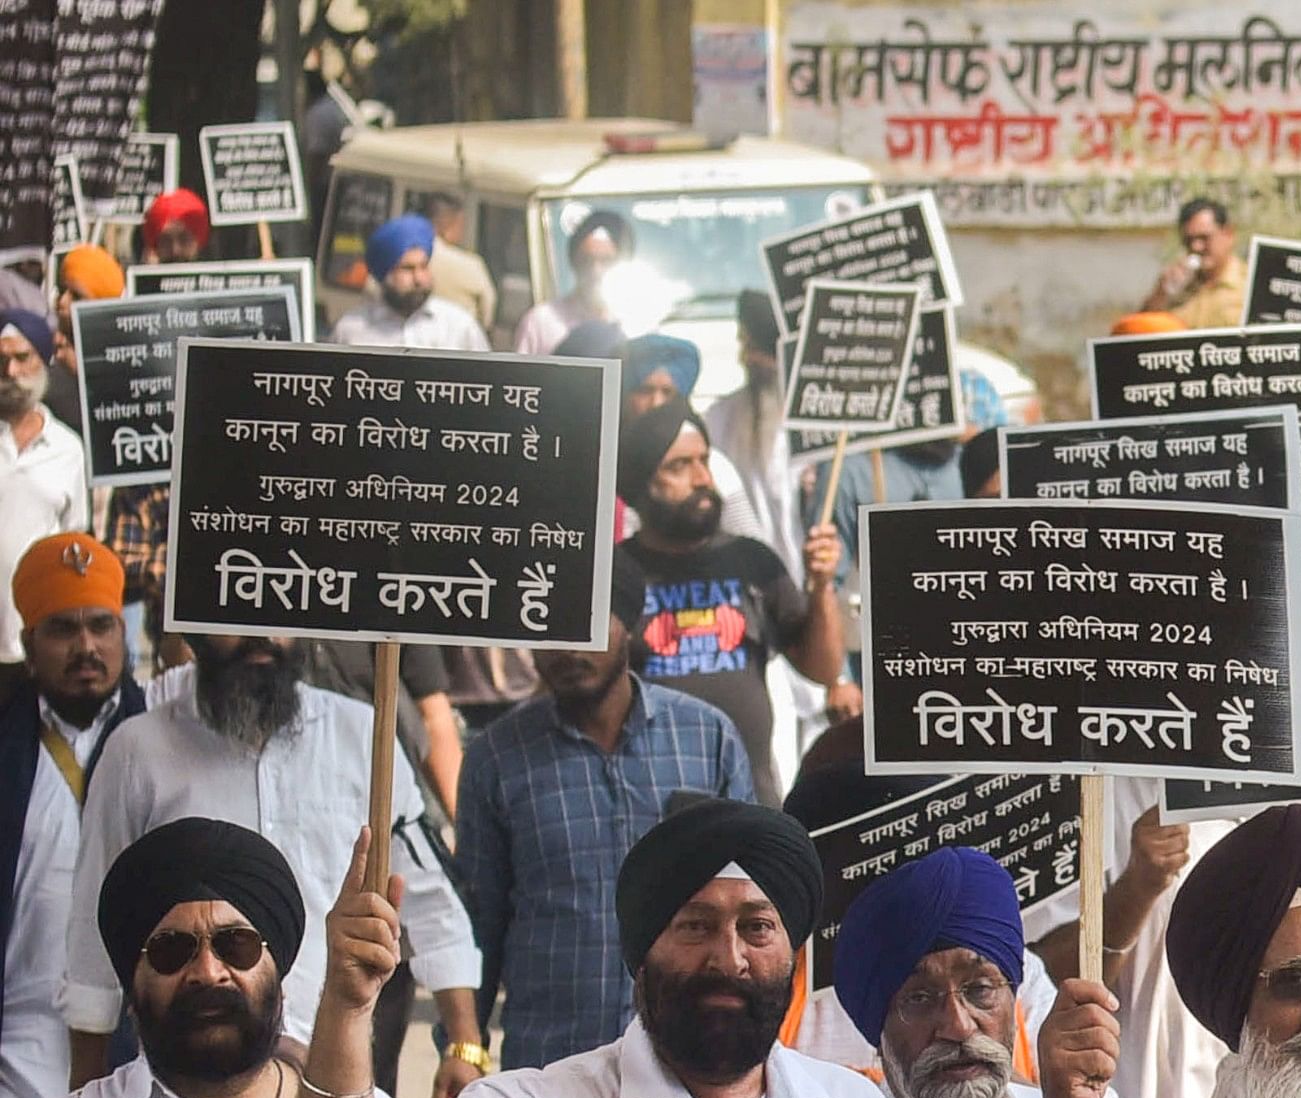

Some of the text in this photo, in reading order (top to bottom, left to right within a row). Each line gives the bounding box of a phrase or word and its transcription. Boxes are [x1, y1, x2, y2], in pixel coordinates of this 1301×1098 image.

[1138, 349, 1195, 374] नागपूर
[1199, 343, 1242, 366] सिख
[1246, 343, 1301, 363] समाज
[253, 369, 542, 413] नागपूर सिख समाज यह
[225, 419, 301, 453] कानून
[311, 423, 347, 446] का
[357, 417, 431, 450] विरोध
[441, 430, 512, 454] करता
[522, 425, 540, 461] है
[1053, 433, 1247, 468] नागपूर सिख समाज यह
[259, 474, 519, 507] गुरुद्वारा अधिनियम 2024
[190, 505, 585, 550] संशोधन का महाराष्ट्र सरकार का निषेध
[936, 520, 1224, 559] नागपूर सिख समाज यह
[215, 549, 556, 631] विरोध करते हैं
[643, 578, 742, 616] SWEAT
[913, 688, 1254, 762] विरोध करते हैं
[856, 792, 968, 844] नागपूर सिख
